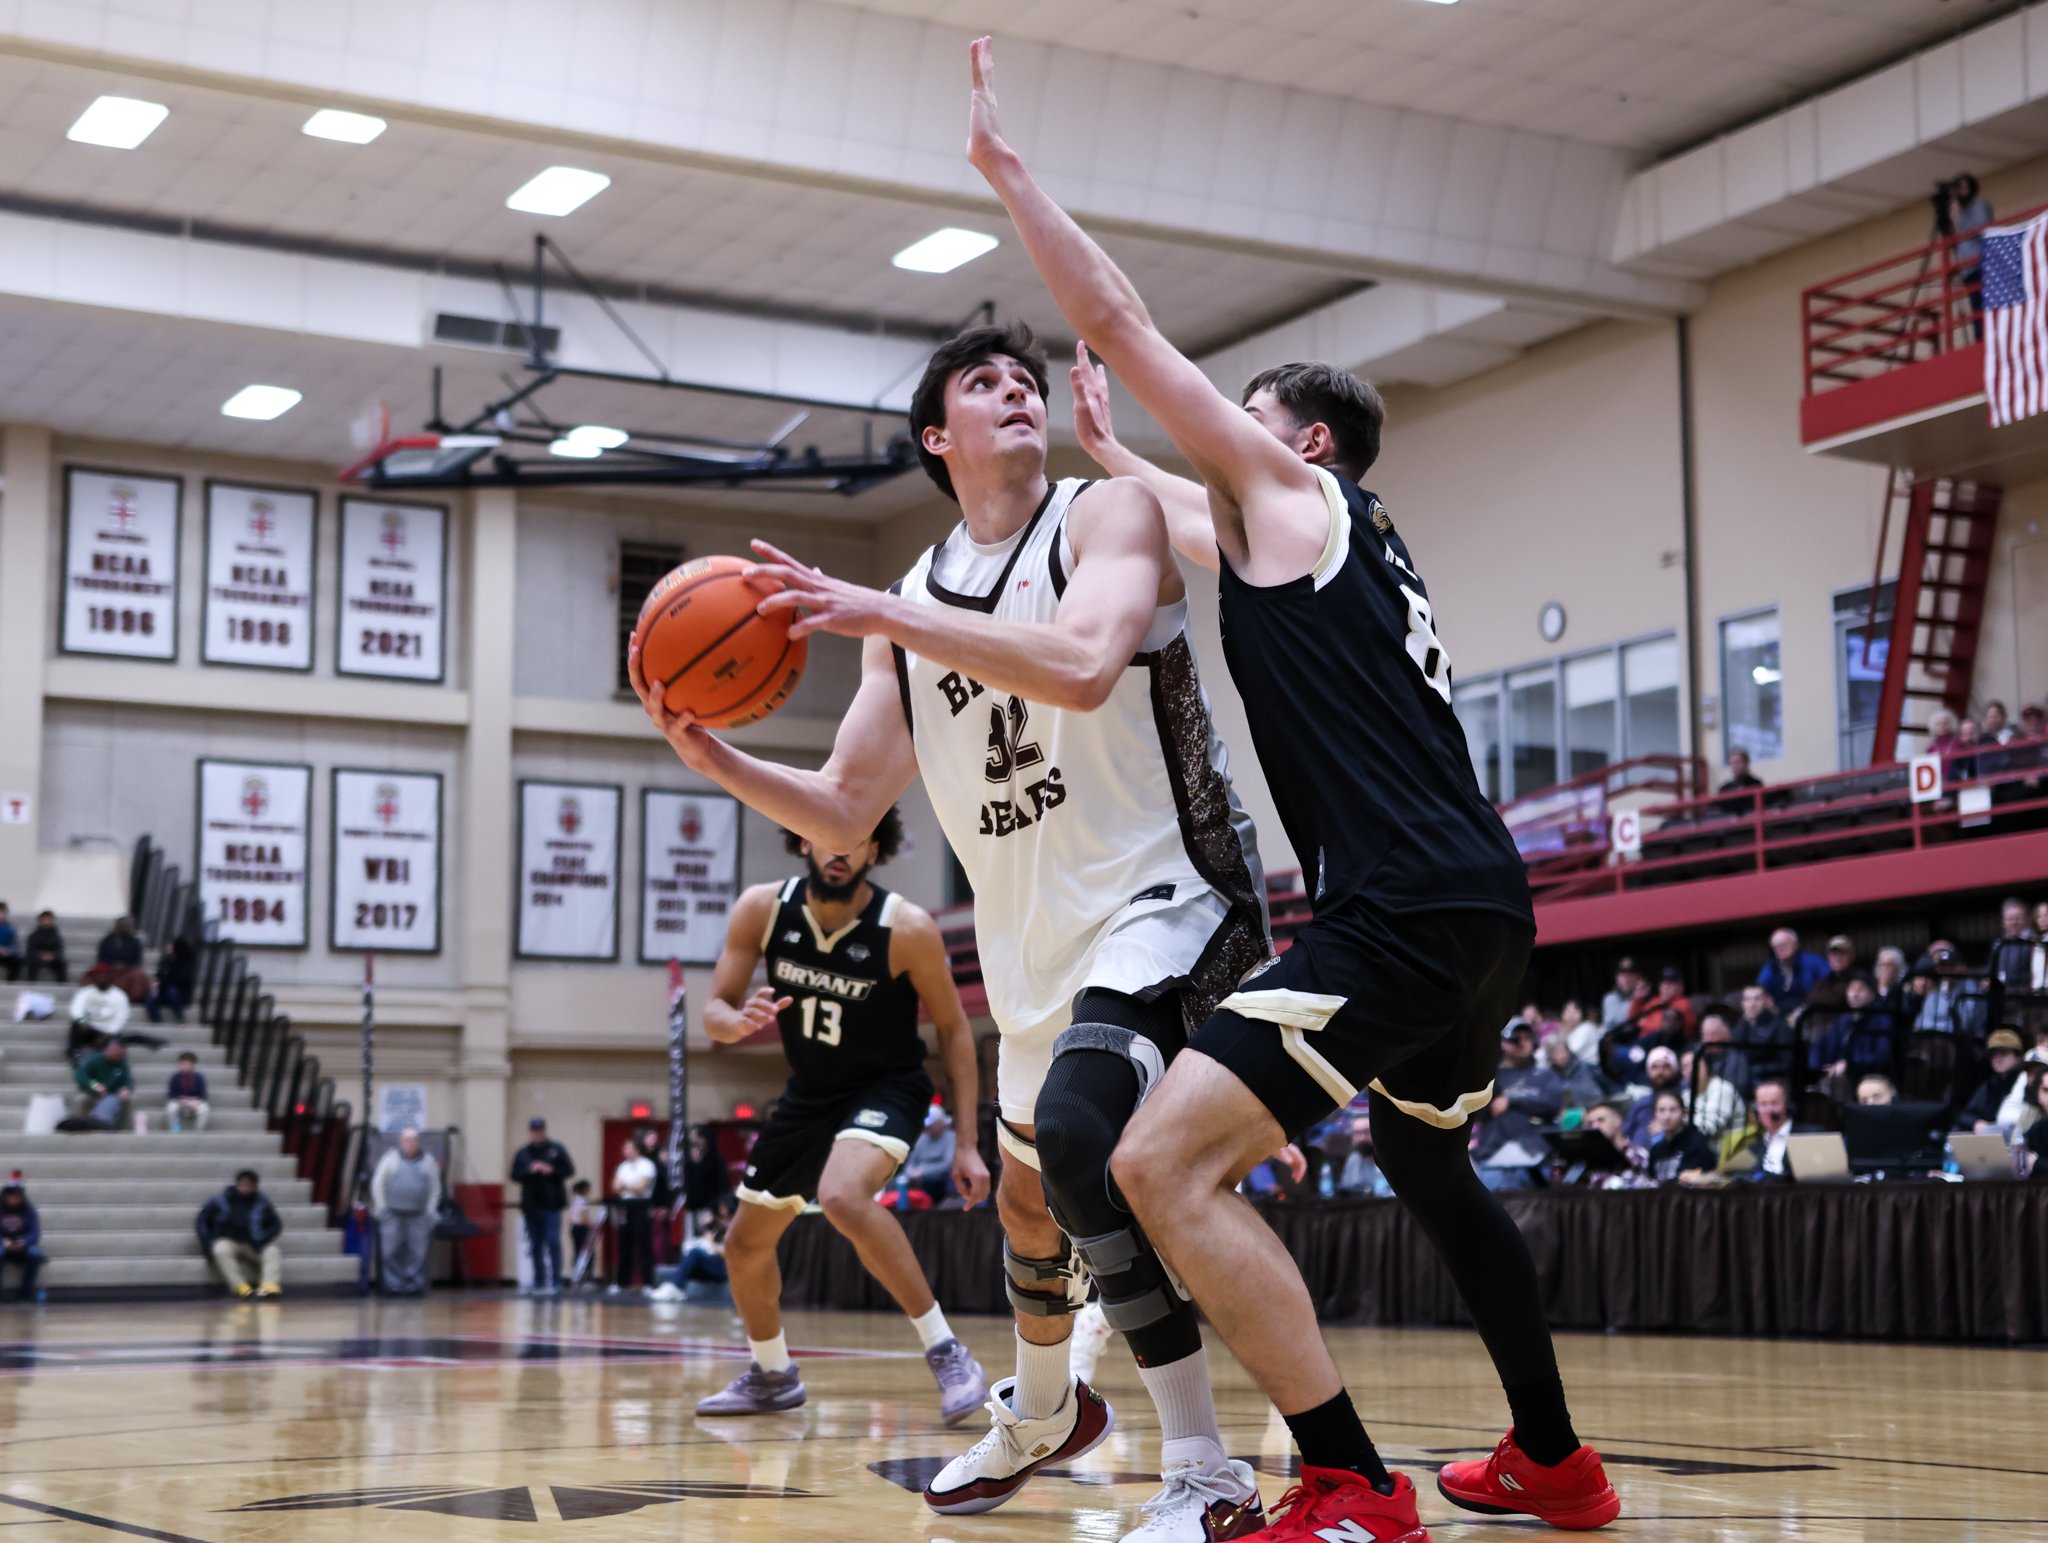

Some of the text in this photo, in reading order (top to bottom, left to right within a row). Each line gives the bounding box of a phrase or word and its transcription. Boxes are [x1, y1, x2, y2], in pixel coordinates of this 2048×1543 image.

[93, 553, 150, 576] NCAA
[231, 565, 287, 587] NCAA
[88, 606, 155, 635] 1996
[361, 629, 421, 658] 2021
[1915, 764, 1937, 793] D
[1618, 816, 1634, 843] C
[225, 844, 281, 865] NCAA
[364, 857, 409, 884] WBI
[220, 897, 285, 923] 1994
[354, 901, 418, 931] 2017
[775, 958, 873, 1000] BRYANT
[801, 996, 843, 1047] 13
